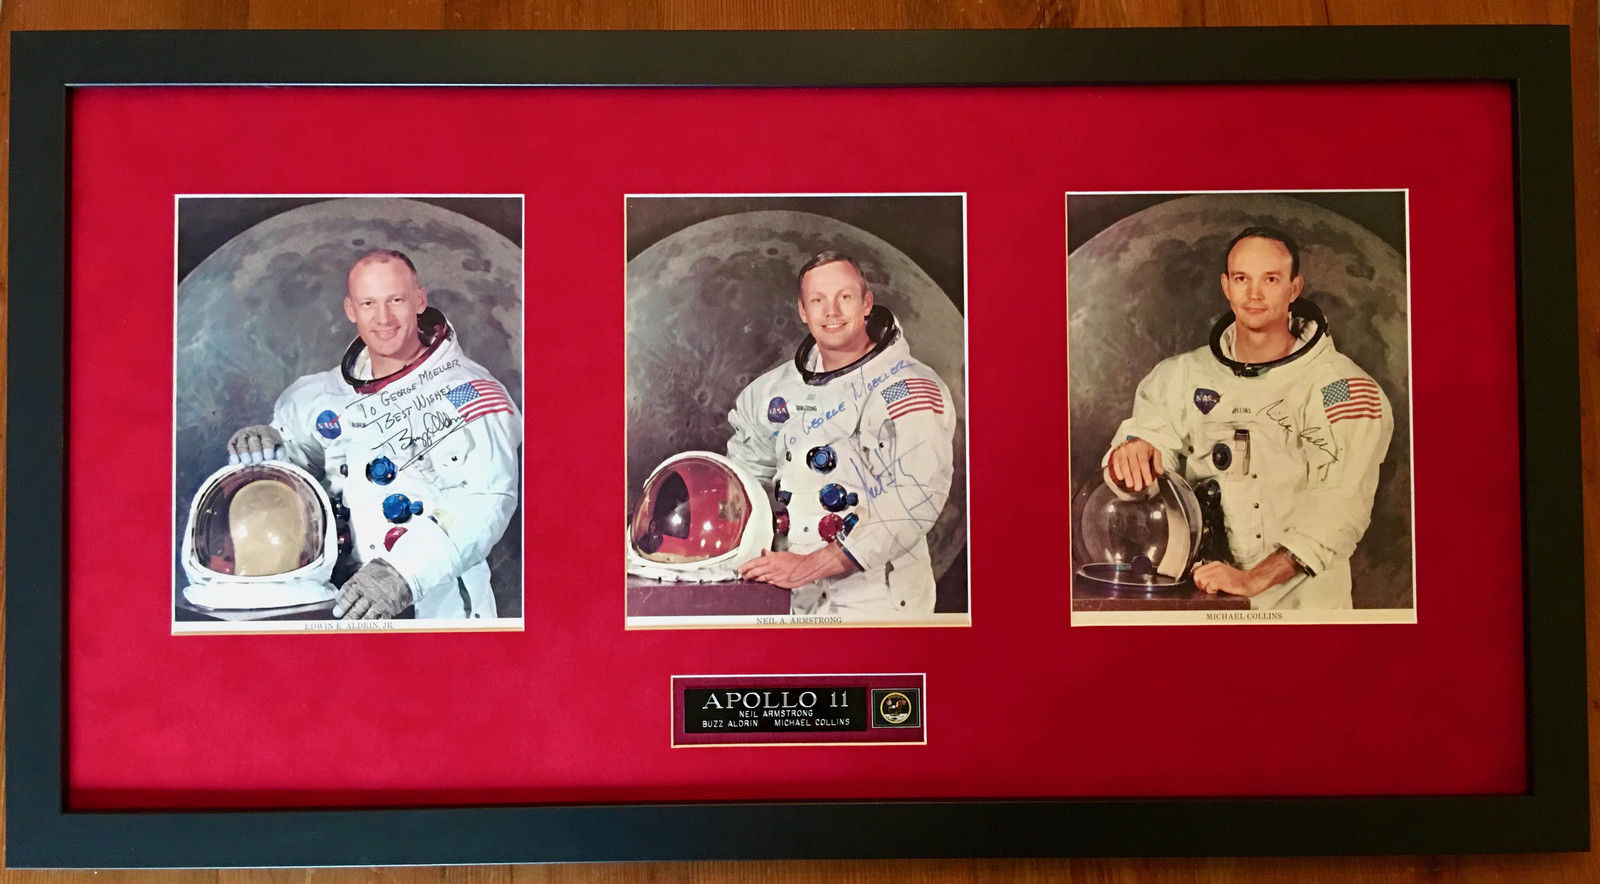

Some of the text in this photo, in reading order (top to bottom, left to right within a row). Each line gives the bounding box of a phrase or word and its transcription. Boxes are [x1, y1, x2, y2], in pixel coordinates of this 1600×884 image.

[380, 384, 417, 407] GEORGE
[418, 358, 461, 386] MOELLER
[363, 385, 452, 433] BEST WISHES
[756, 617, 777, 625] NEIL
[790, 616, 842, 624] ARMSTRONG
[1247, 612, 1282, 620] COLLINS
[702, 691, 849, 710] APOLLO 11
[762, 710, 814, 718] ARMSTRONG
[702, 718, 850, 728] BUZZ ALDRIN MICHAEL COLLINS
